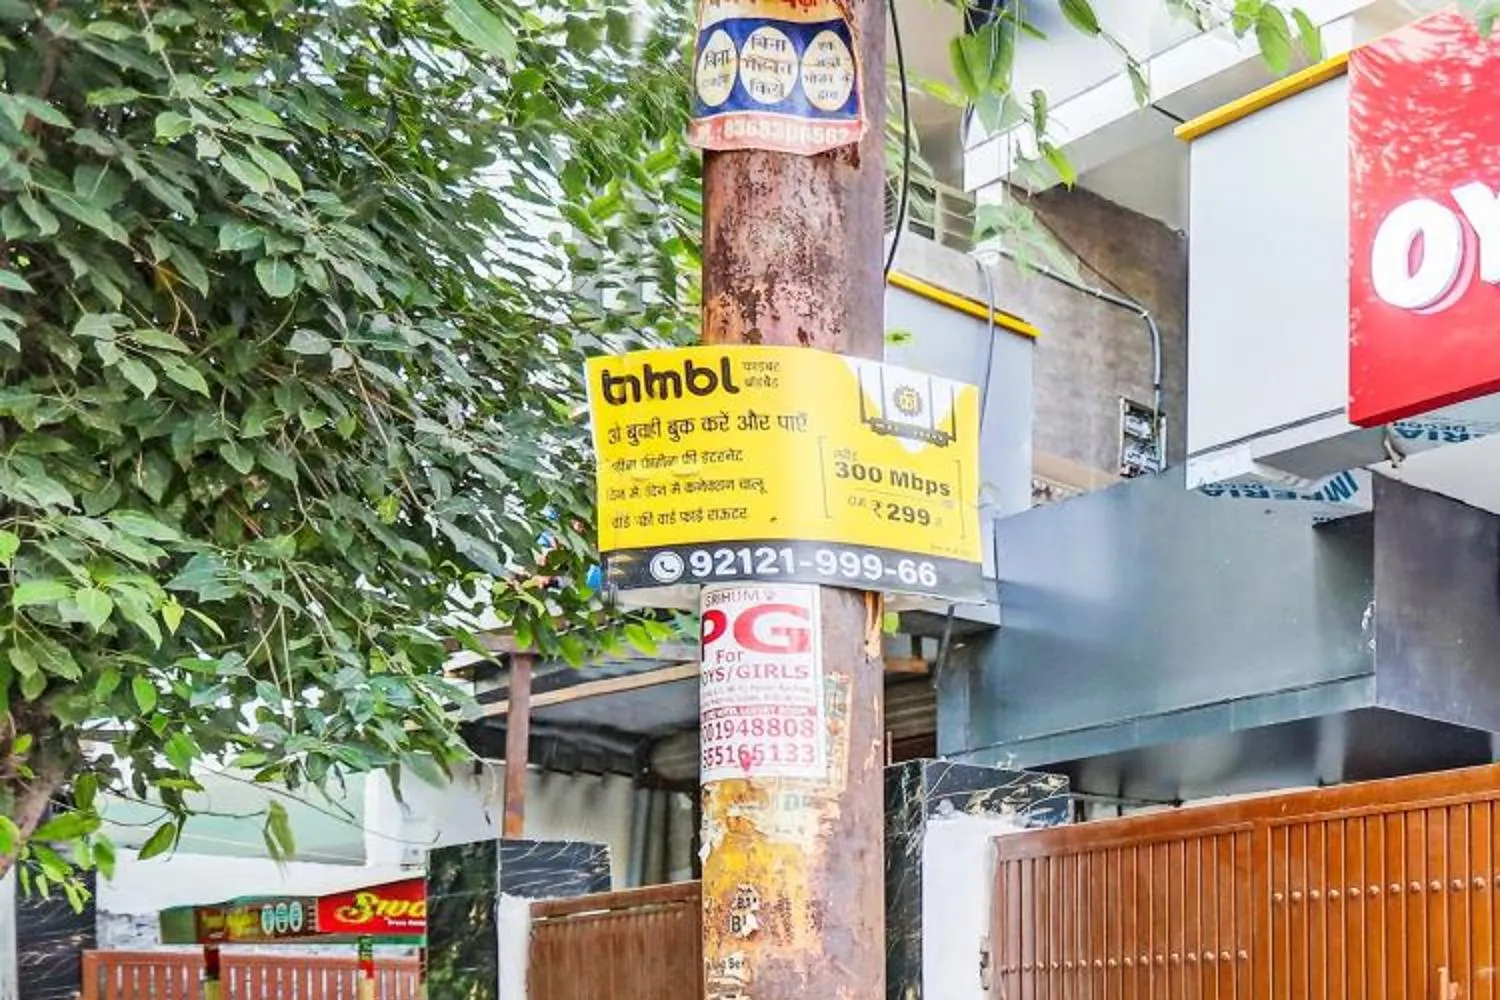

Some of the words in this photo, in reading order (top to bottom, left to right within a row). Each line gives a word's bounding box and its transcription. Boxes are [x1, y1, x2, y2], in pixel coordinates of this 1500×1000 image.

[737, 409, 771, 432] और
[835, 461, 883, 484] 300
[890, 468, 951, 497] Mbps
[690, 547, 938, 587] 92121-999-66
